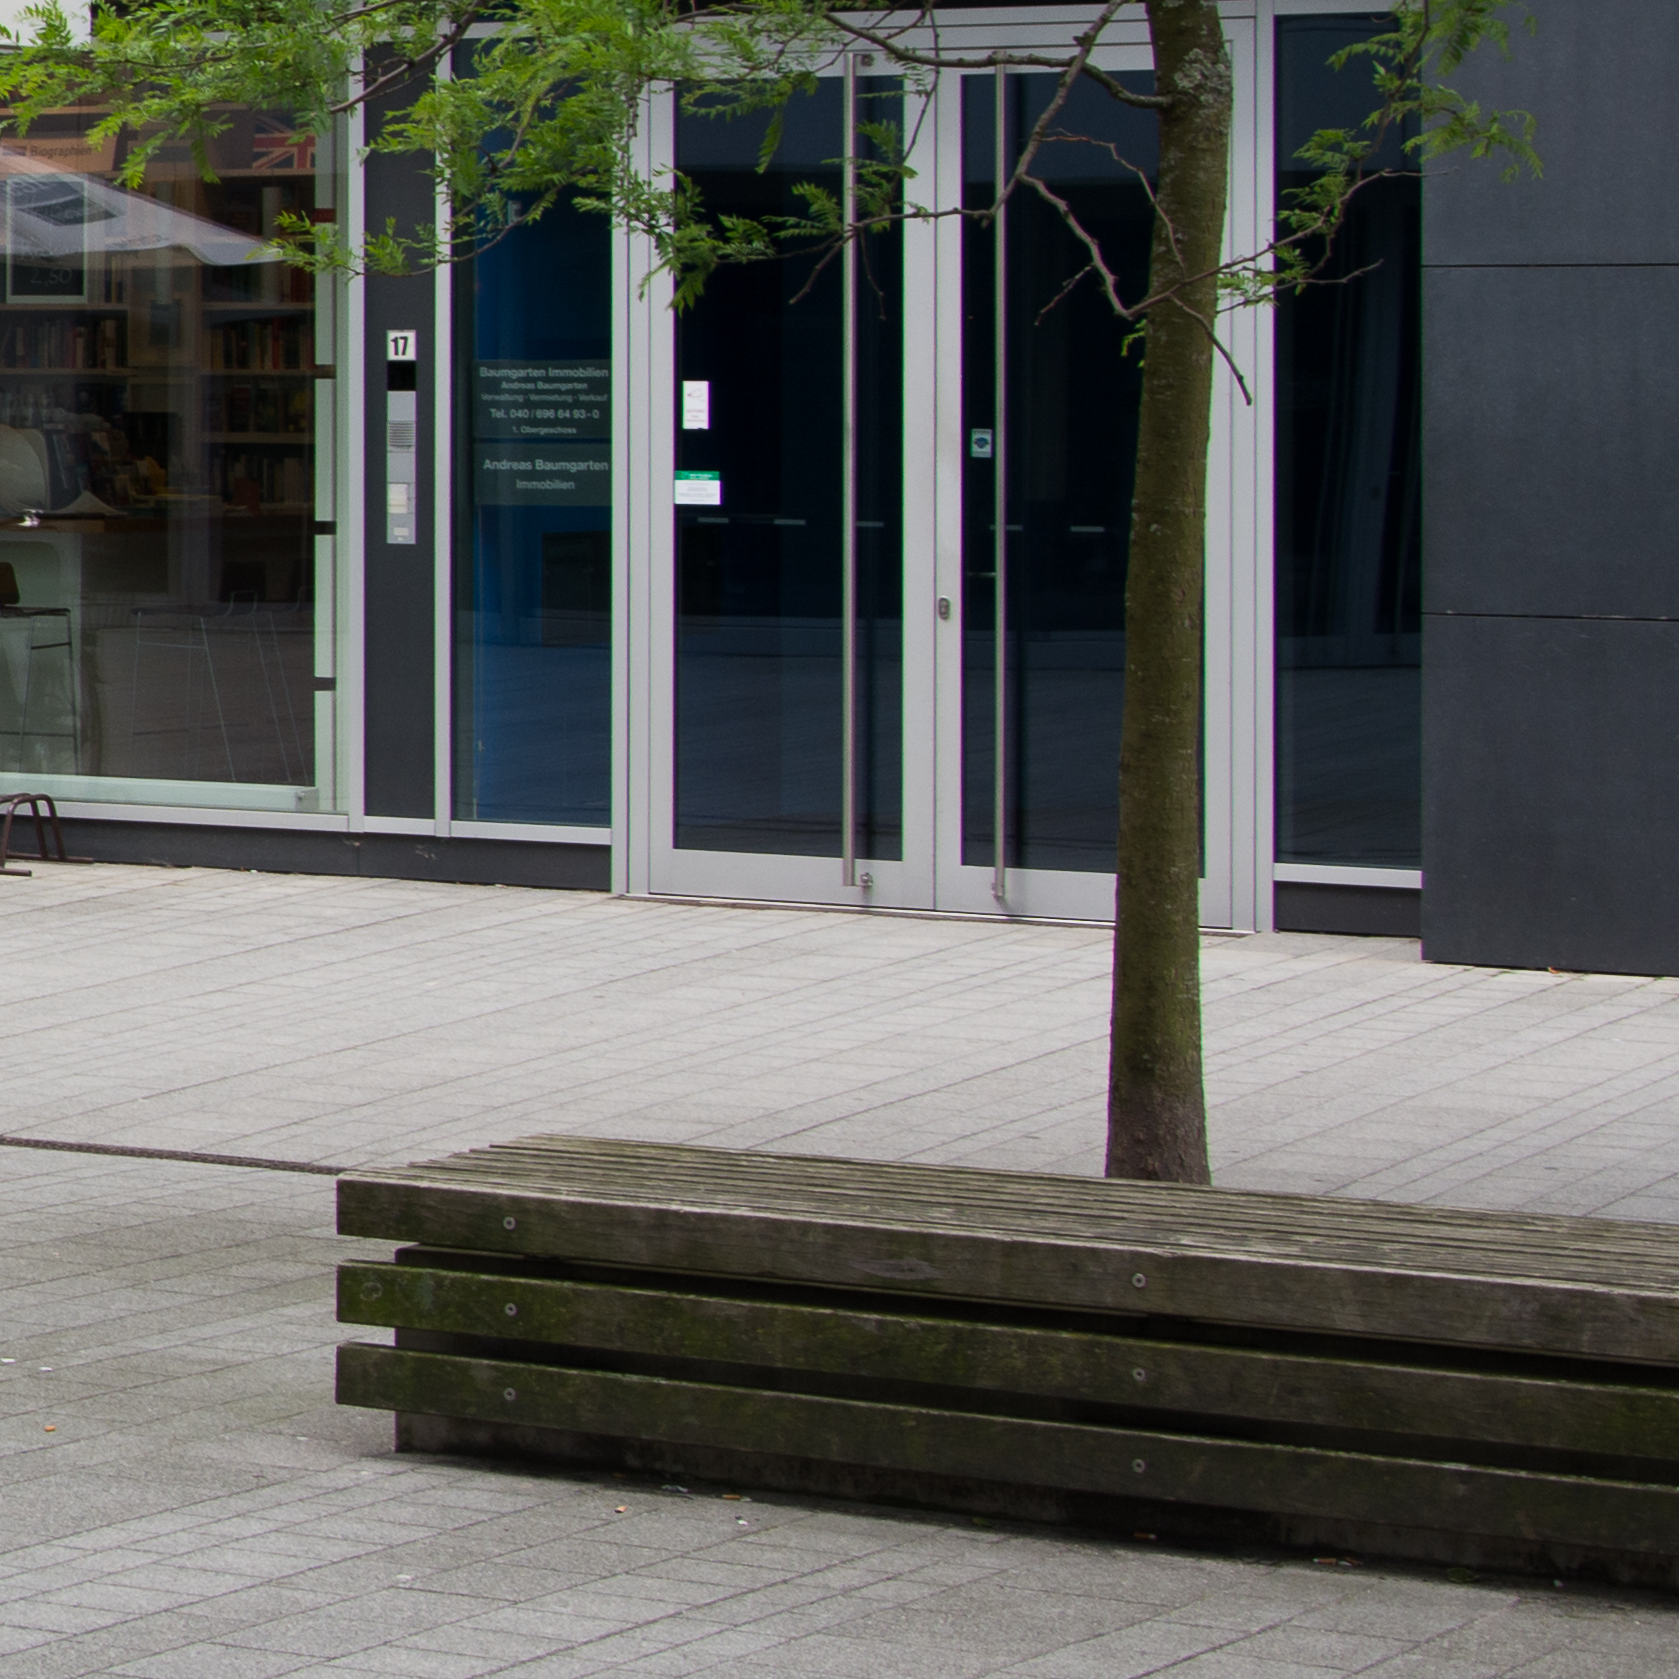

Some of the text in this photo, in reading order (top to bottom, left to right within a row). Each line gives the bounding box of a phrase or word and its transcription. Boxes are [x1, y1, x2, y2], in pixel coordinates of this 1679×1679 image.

[391, 336, 409, 356] 17
[479, 366, 609, 379] Baumgarten Immobilien
[501, 381, 588, 391] Andreas Baumgarten
[490, 409, 508, 418] Tel.
[484, 459, 609, 473] Andreas Baumgarten
[516, 479, 575, 490] Immobilien
